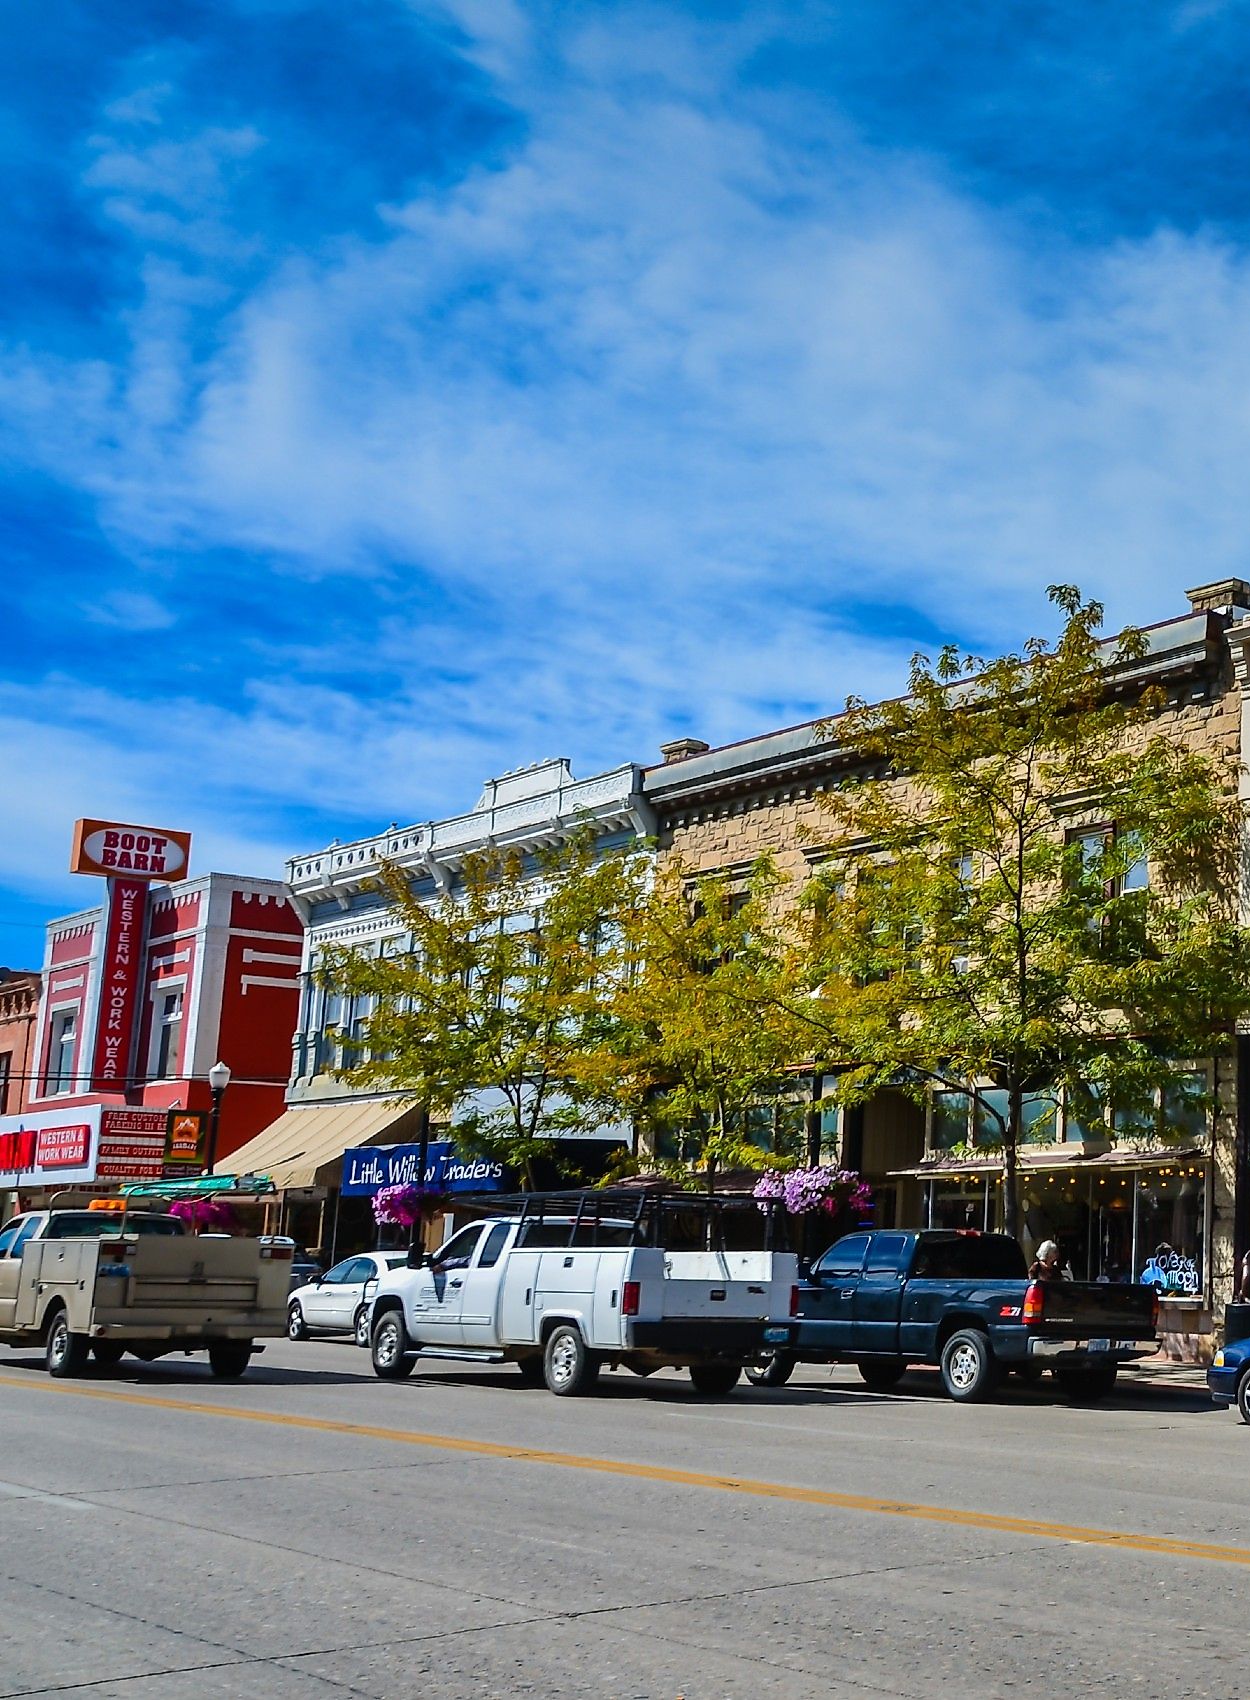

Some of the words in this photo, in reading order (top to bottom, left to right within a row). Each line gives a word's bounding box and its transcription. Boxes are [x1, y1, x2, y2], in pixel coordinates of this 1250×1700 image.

[104, 830, 168, 854] BOOT
[102, 849, 166, 872] BARN
[115, 888, 138, 965] WESTERN
[113, 969, 127, 981] &
[108, 986, 127, 1030] WORK
[107, 1111, 128, 1120] FREE
[40, 1130, 76, 1145] WESTERN
[77, 1129, 84, 1142] &
[38, 1149, 60, 1161] WORK
[61, 1145, 84, 1159] WEAR
[101, 1145, 130, 1155] FAMILY
[103, 1165, 137, 1174] QUALITY
[139, 1166, 153, 1175] FOR
[348, 1157, 385, 1185] Little
[439, 1155, 503, 1181] Traders
[1000, 1306, 1022, 1317] Z71
